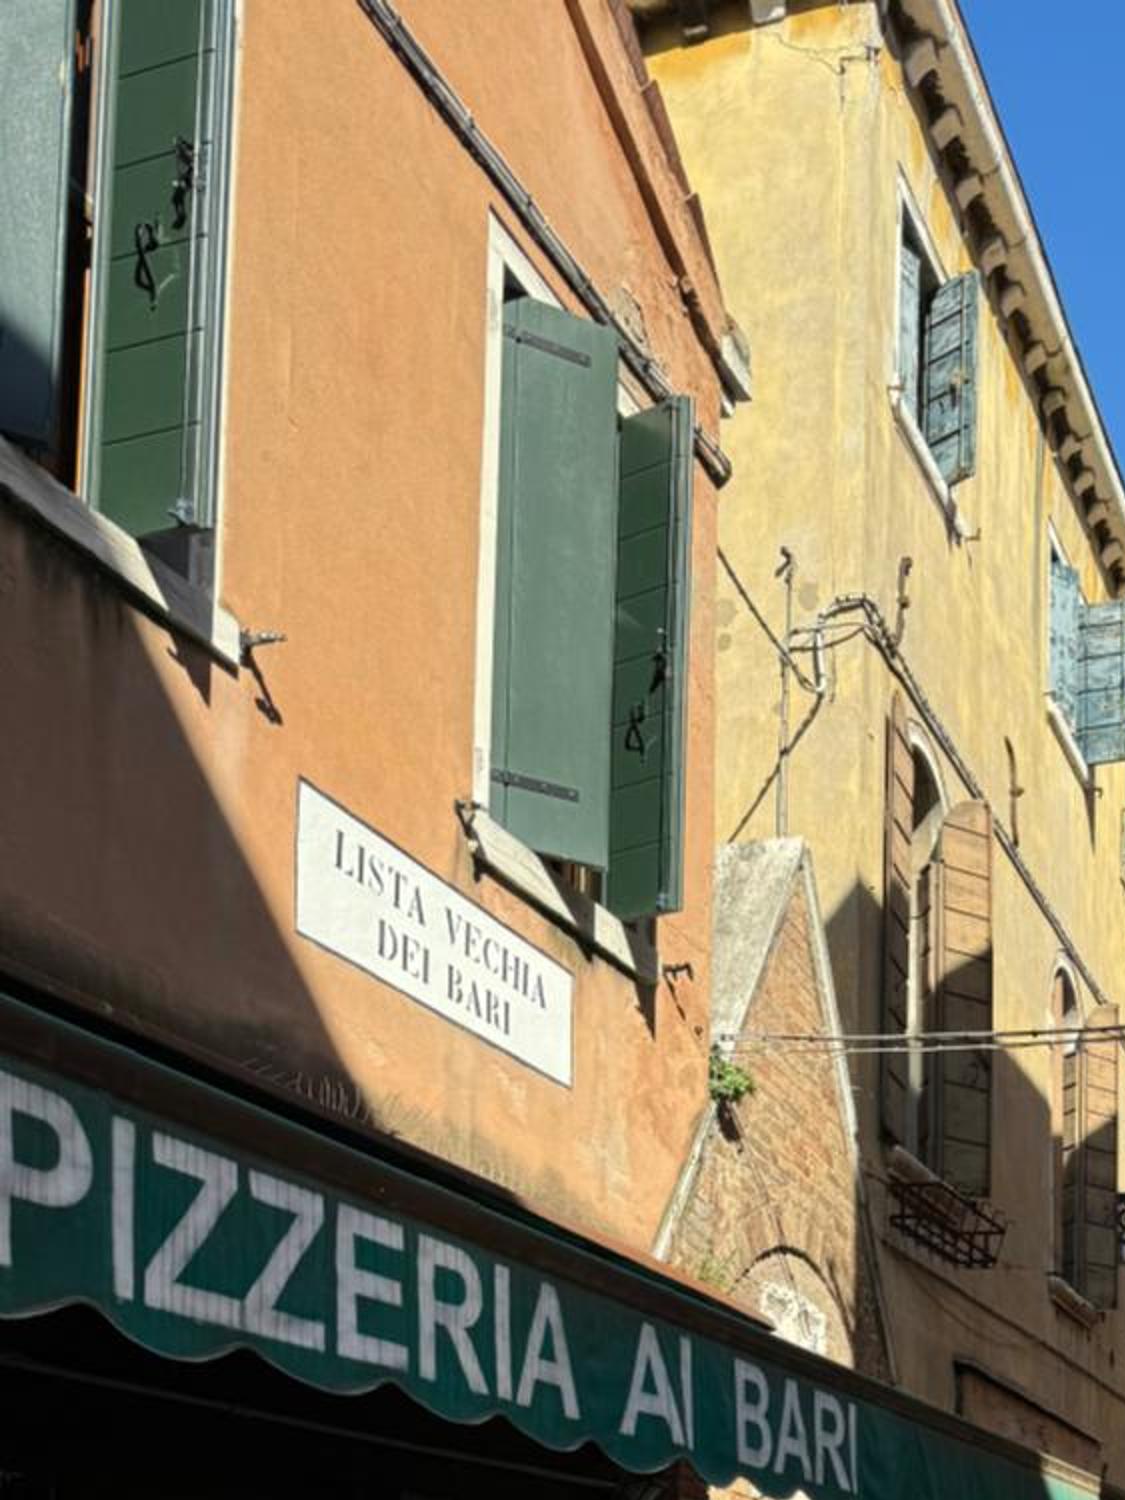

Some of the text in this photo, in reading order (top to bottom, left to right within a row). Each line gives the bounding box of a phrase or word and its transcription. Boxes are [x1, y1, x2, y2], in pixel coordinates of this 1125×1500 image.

[334, 828, 547, 1010] LISTA VECHIA
[377, 918, 510, 1036] DEI BARI
[0, 1068, 859, 1496] PIZZERIA AI BARI
